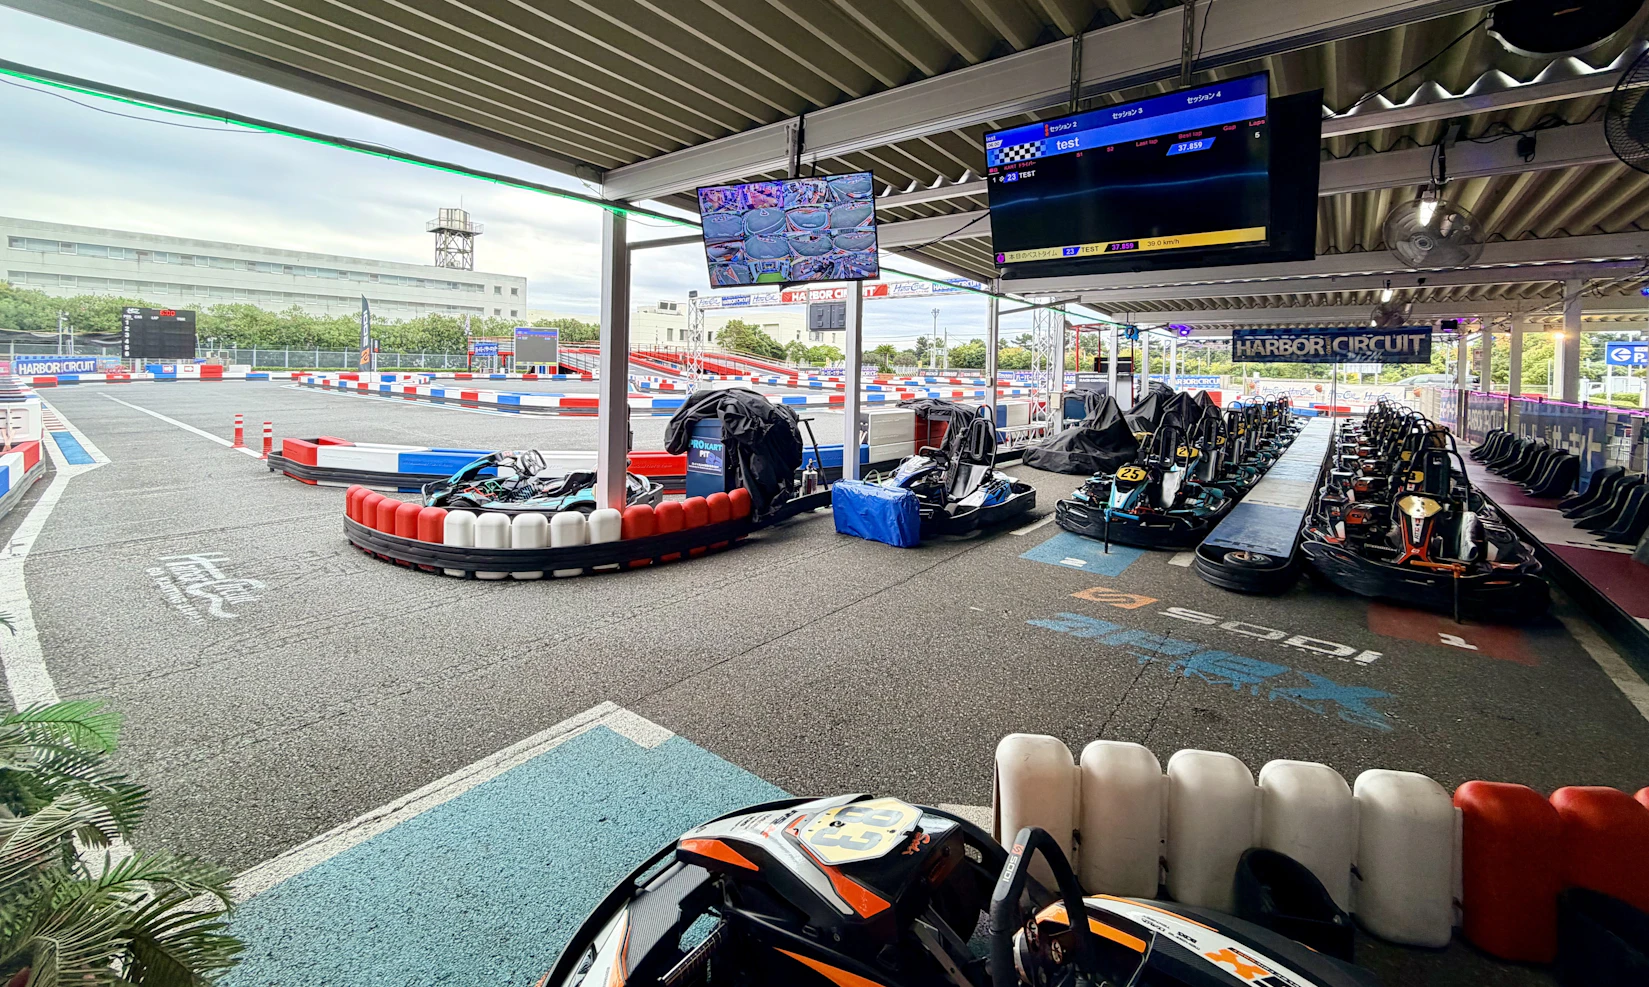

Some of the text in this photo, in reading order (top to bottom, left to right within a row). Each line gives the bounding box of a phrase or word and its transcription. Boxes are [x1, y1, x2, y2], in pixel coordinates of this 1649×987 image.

[1187, 92, 1215, 104] セッション
[1112, 109, 1137, 120] セッション
[1050, 122, 1071, 133] セッション
[1249, 119, 1265, 127] Laps
[1056, 136, 1080, 151] test
[1178, 141, 1203, 152] 37.859
[1007, 173, 1017, 181] 23
[1019, 170, 1036, 179] TEST
[1111, 242, 1134, 251] 37.859
[1236, 336, 1325, 356] HARBOR
[1332, 334, 1426, 354] CIRCUIT
[18, 360, 95, 375] HARBOR CIRCUIT
[688, 439, 723, 452] PRO KART
[699, 450, 710, 458] PIT
[1121, 468, 1139, 480] 25
[1157, 605, 1383, 667] SODI
[1002, 856, 1018, 883] SODI
